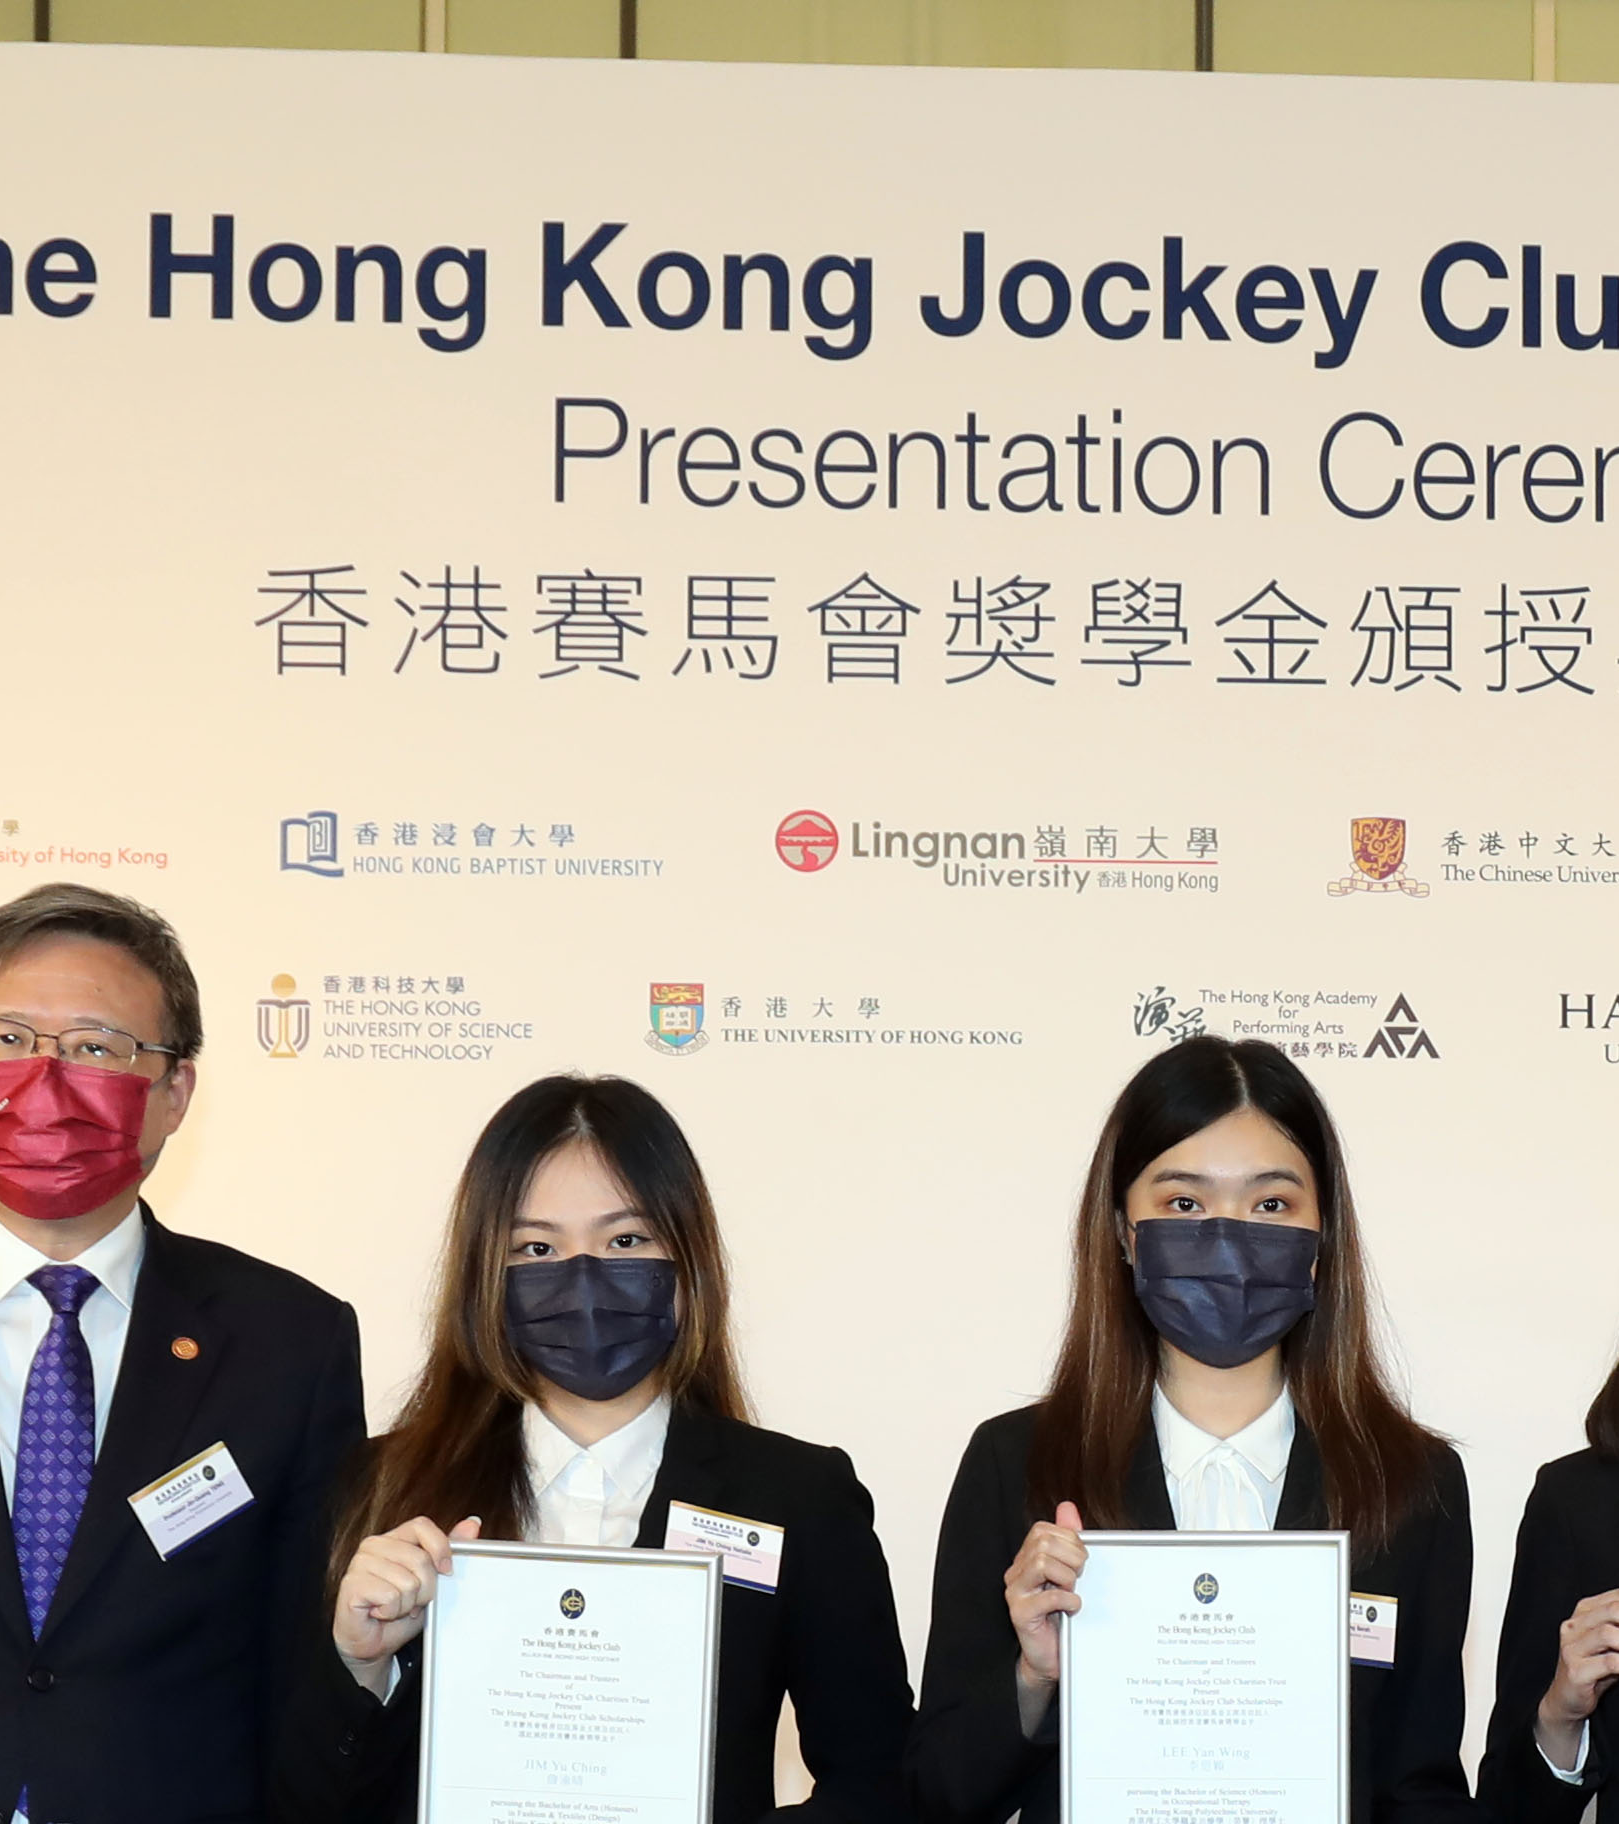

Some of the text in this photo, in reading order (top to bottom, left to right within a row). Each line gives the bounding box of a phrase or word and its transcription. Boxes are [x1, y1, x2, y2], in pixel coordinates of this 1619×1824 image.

[149, 212, 487, 354] Hong
[541, 221, 873, 362] Kong
[919, 231, 1379, 370] Jockey
[554, 397, 1270, 516] Presentation
[354, 821, 575, 848] 香港浸會大學
[852, 820, 1026, 869] Lingnan
[1033, 824, 1218, 858] 嶺南大學
[33, 845, 55, 864] of
[59, 847, 113, 870] Hong
[117, 847, 169, 870] Kong
[352, 855, 665, 877] HONG KONG BAPTIST UNIVERSITY
[943, 863, 1091, 893] University
[1096, 870, 1128, 889] 香港
[1131, 870, 1219, 894] Hong Kong
[1440, 863, 1476, 882] The
[1478, 863, 1554, 883] Chinese
[323, 974, 465, 995] 香港科技大學
[322, 998, 482, 1017] THE HONG KONG
[721, 995, 881, 1020] 香港大學
[1197, 988, 1378, 1009] The Hong Kong Academy
[1277, 1004, 1300, 1020] for
[323, 1021, 533, 1040] UNIVERSITY OF SCIENCE
[720, 1028, 759, 1043] THE
[763, 1028, 876, 1044] UNIVERSITY
[880, 1030, 906, 1044] OF
[909, 1030, 964, 1045] HONG
[968, 1030, 1023, 1045] KONG
[1232, 1019, 1345, 1039] Performing Arts
[322, 1043, 494, 1061] AND TECHNOLOGY
